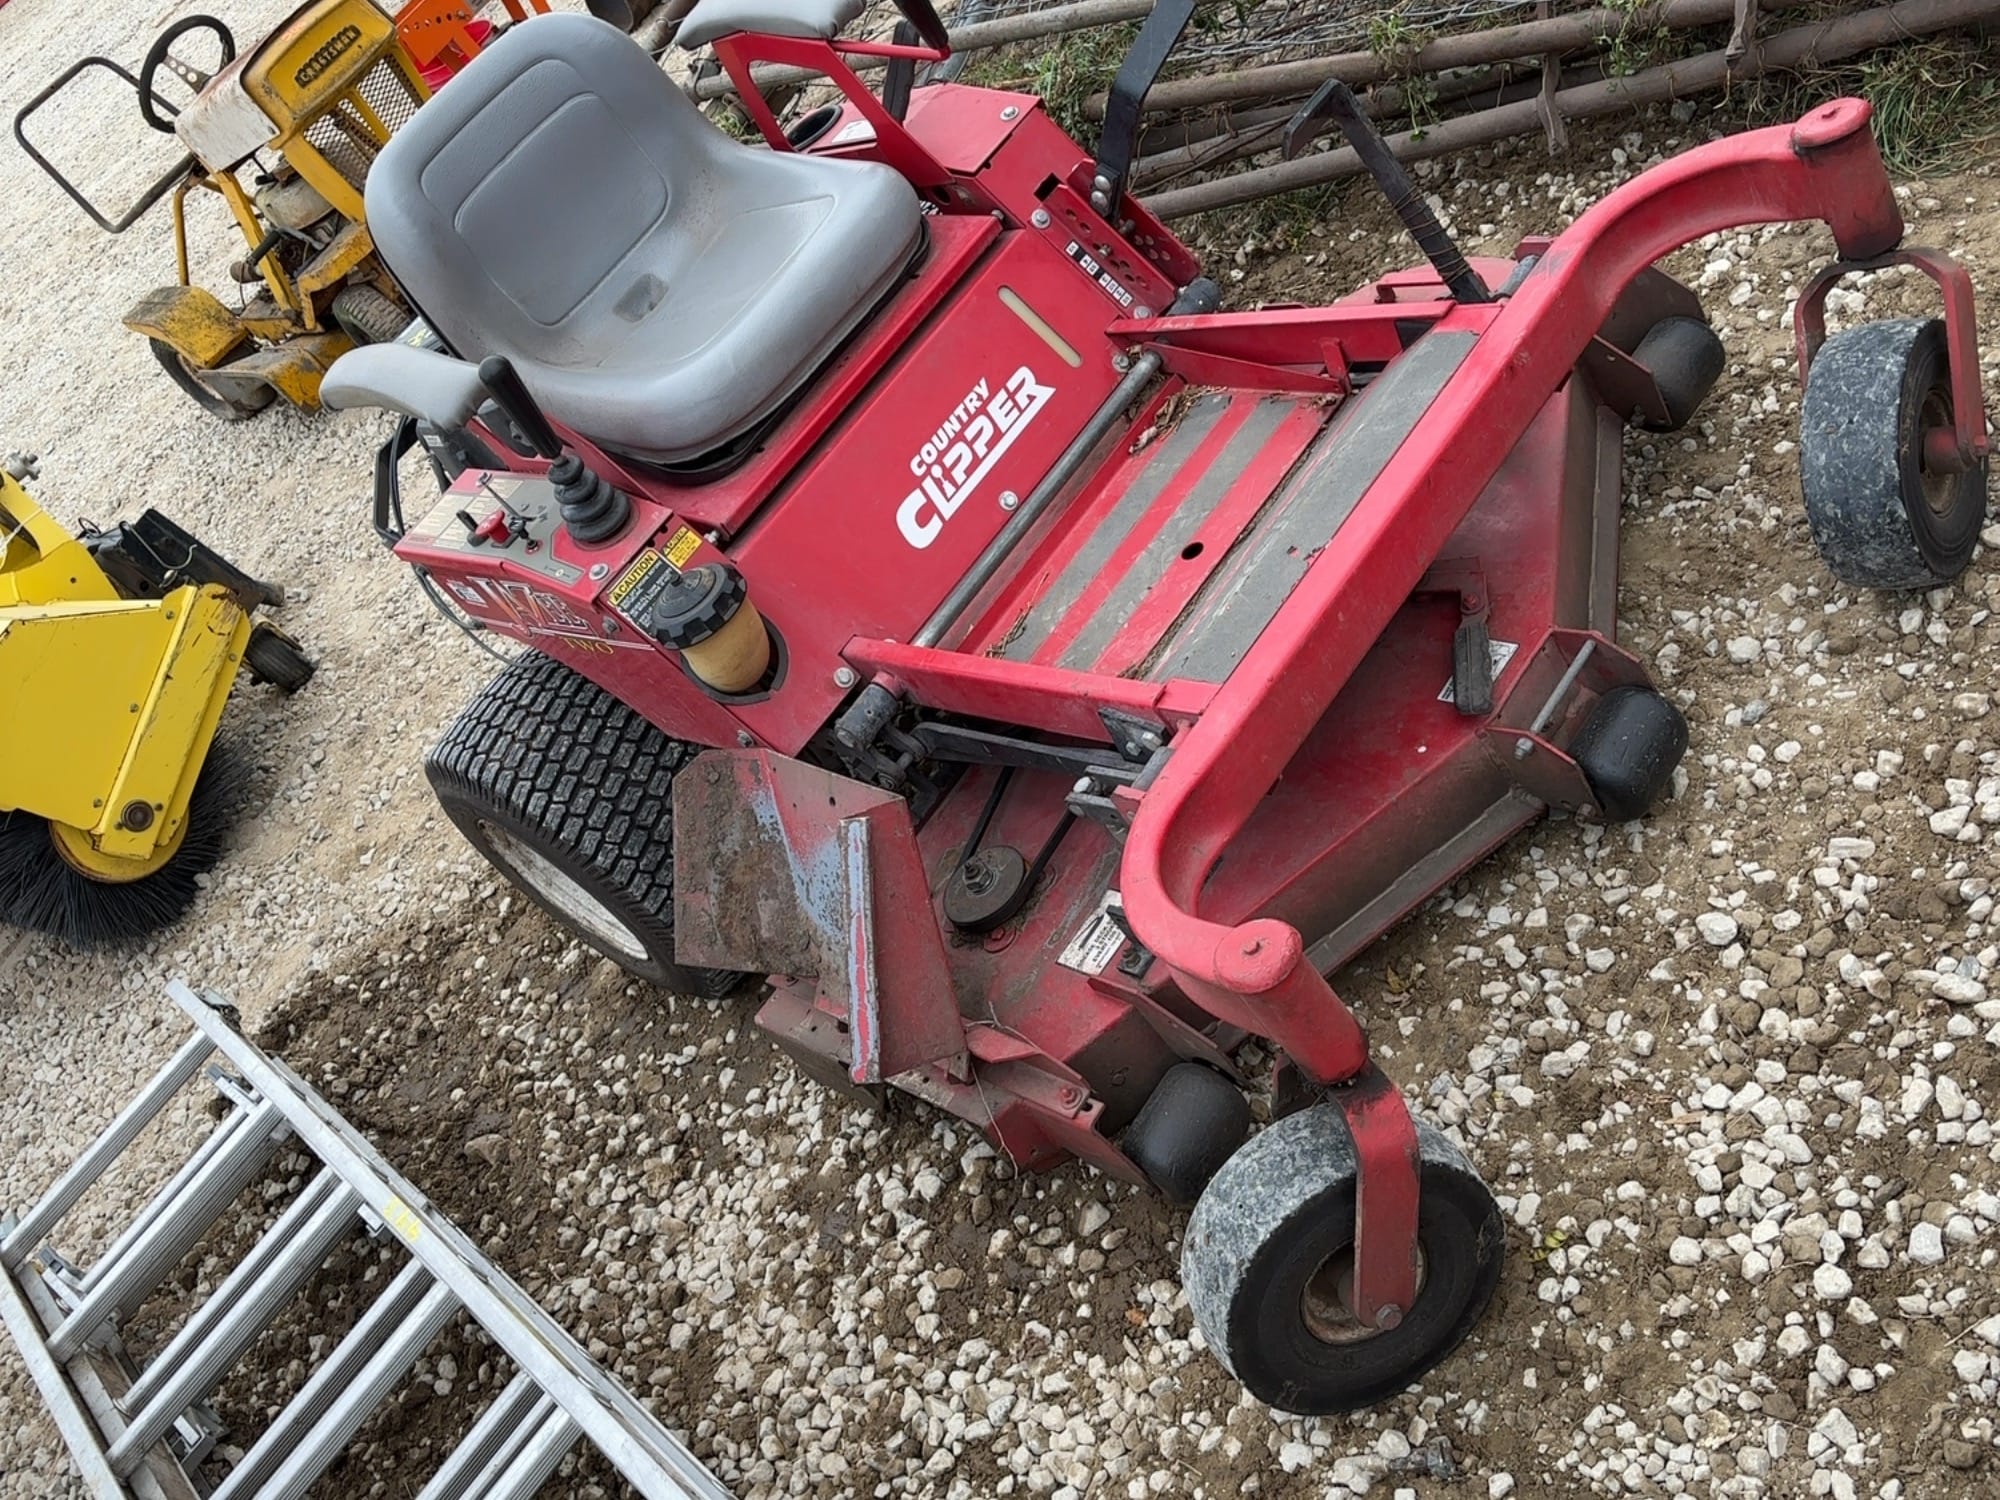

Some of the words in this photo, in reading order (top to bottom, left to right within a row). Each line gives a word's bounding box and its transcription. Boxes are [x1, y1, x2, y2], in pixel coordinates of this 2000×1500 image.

[297, 28, 356, 82] CRAFTSMAN
[910, 377, 990, 477] COUNTRY
[896, 365, 1056, 549] CLIPPER
[618, 554, 654, 594] CAUTION
[560, 636, 614, 654] TWO
